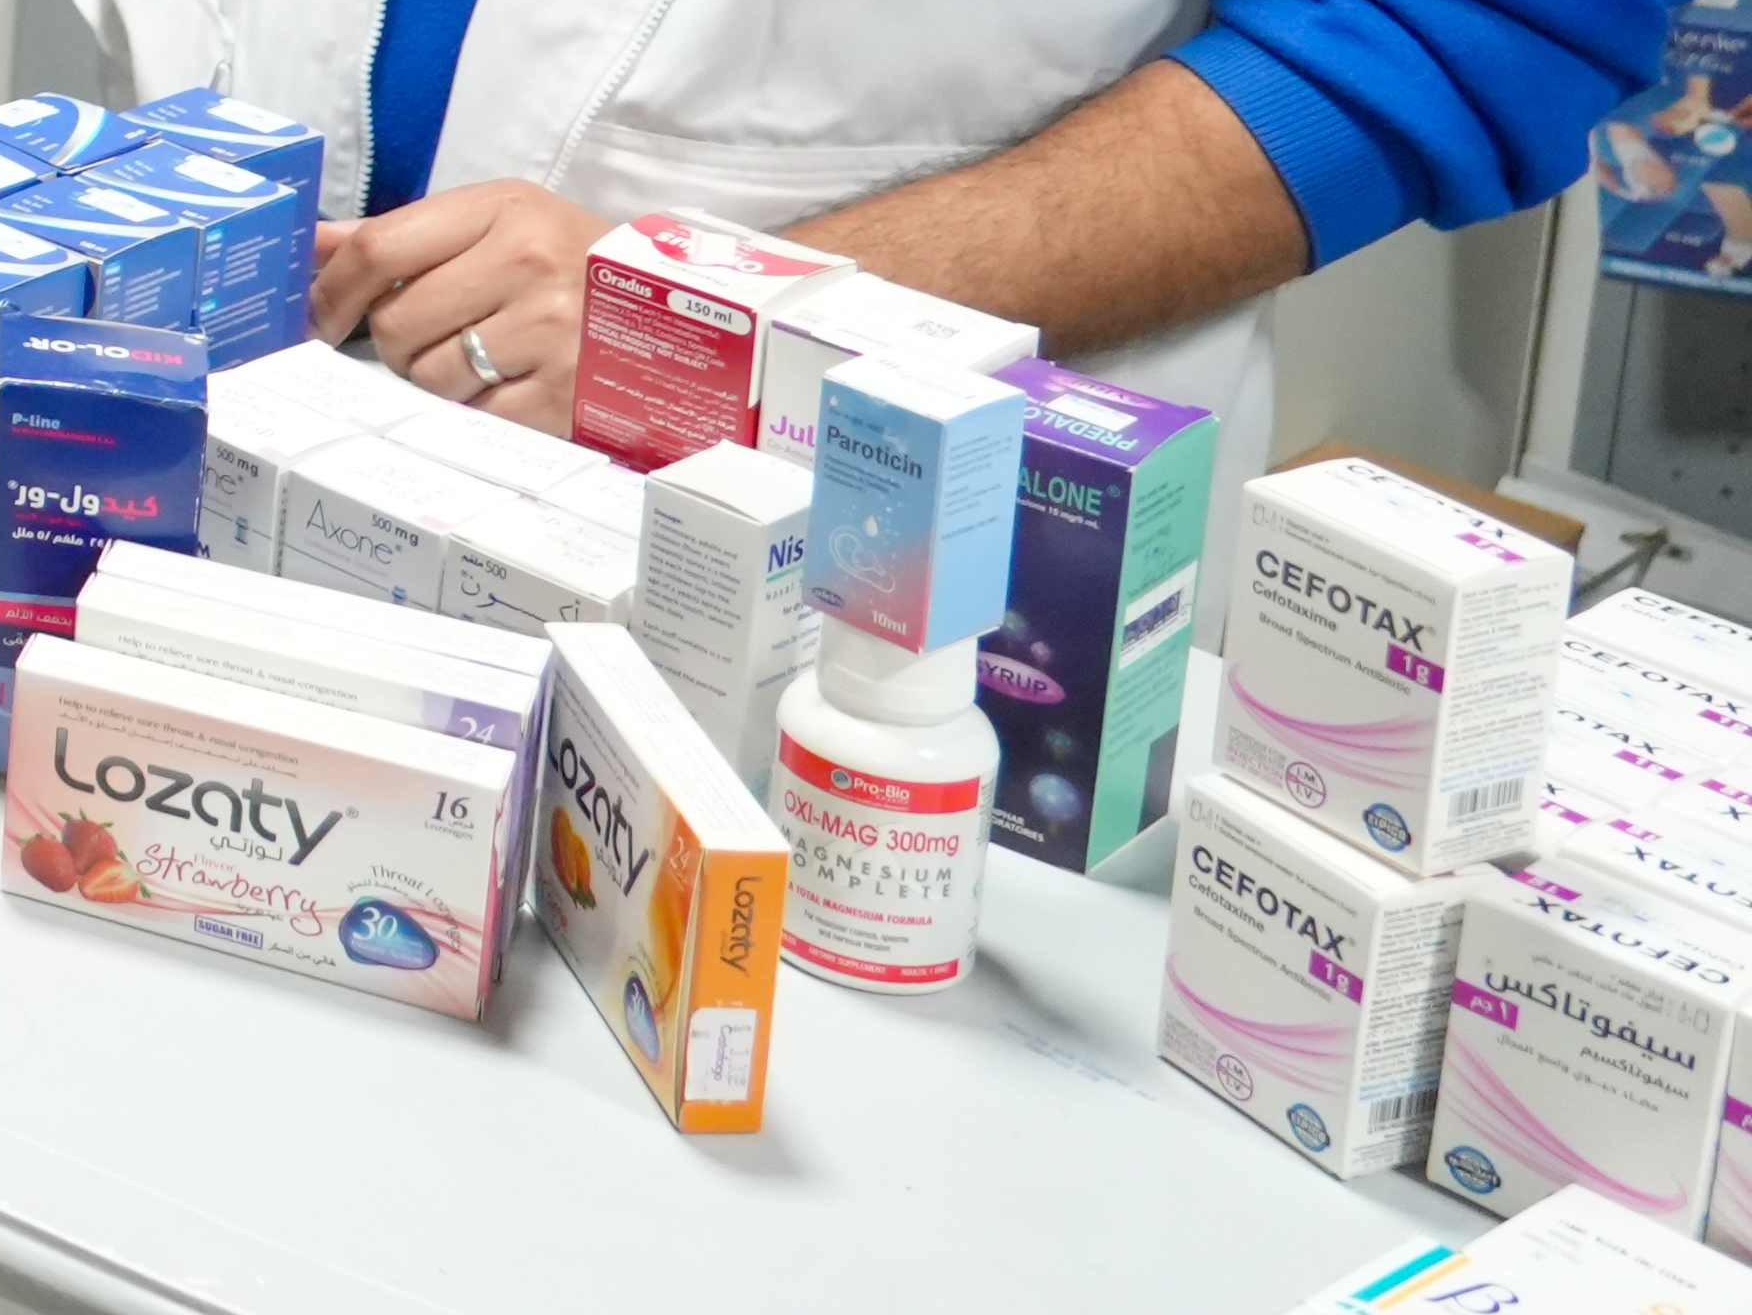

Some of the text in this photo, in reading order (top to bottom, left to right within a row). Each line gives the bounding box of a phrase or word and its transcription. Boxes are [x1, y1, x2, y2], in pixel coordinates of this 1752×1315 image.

[597, 267, 654, 299] Oradus
[684, 298, 733, 325] 150 ml
[29, 336, 185, 367] KIDOL-OR
[216, 446, 260, 479] 500 mg
[825, 423, 924, 480] Paroticin
[1017, 465, 1104, 517] ALONE
[305, 500, 420, 566] Axone 500 mg
[766, 535, 804, 574] Nis
[484, 559, 508, 582] 500
[1252, 580, 1338, 633] Cefotaxime
[1255, 549, 1428, 653] CEFOTAX
[117, 632, 141, 649] Help
[157, 641, 194, 662] relieve
[196, 653, 221, 668] sore
[222, 658, 255, 678] throat
[267, 670, 296, 686] nasal
[297, 678, 359, 704] congestion
[1258, 611, 1412, 696] Broad Spectrum Antibiotic
[1562, 640, 1745, 714] CEFOTAX
[57, 694, 84, 713] Help
[98, 704, 134, 725] relieve
[136, 716, 161, 731] sore
[162, 720, 195, 742] throat
[209, 733, 237, 751] nasal
[237, 741, 299, 767] congestion
[54, 727, 343, 867] Lozaty
[429, 789, 472, 823] 16
[852, 774, 911, 801] Pro-Bio
[208, 834, 284, 863] لوزتي
[422, 818, 474, 843] Lozenges
[784, 789, 960, 858] OXI-MAG 300mg
[193, 851, 237, 874] Flavor
[369, 863, 424, 894] Throat
[780, 823, 953, 882] MAGNESIUM
[792, 852, 951, 899] OMPLETE
[134, 843, 324, 938] Strawberry
[795, 884, 822, 905] TOTAL
[822, 897, 885, 923] MAGNESIUM
[886, 912, 933, 926] FORMULA
[1188, 874, 1266, 933] Cefotaxime
[1191, 844, 1347, 962] CEFOTAX
[196, 918, 262, 947] SUGAR FREE
[351, 906, 400, 941] 30
[719, 875, 764, 979] Lozaty
[1526, 894, 1731, 986] CEFOTAX
[1193, 905, 1333, 1003] Broad Spectrum Antibiotic
[1484, 971, 1695, 1072] سيفوتاكس
